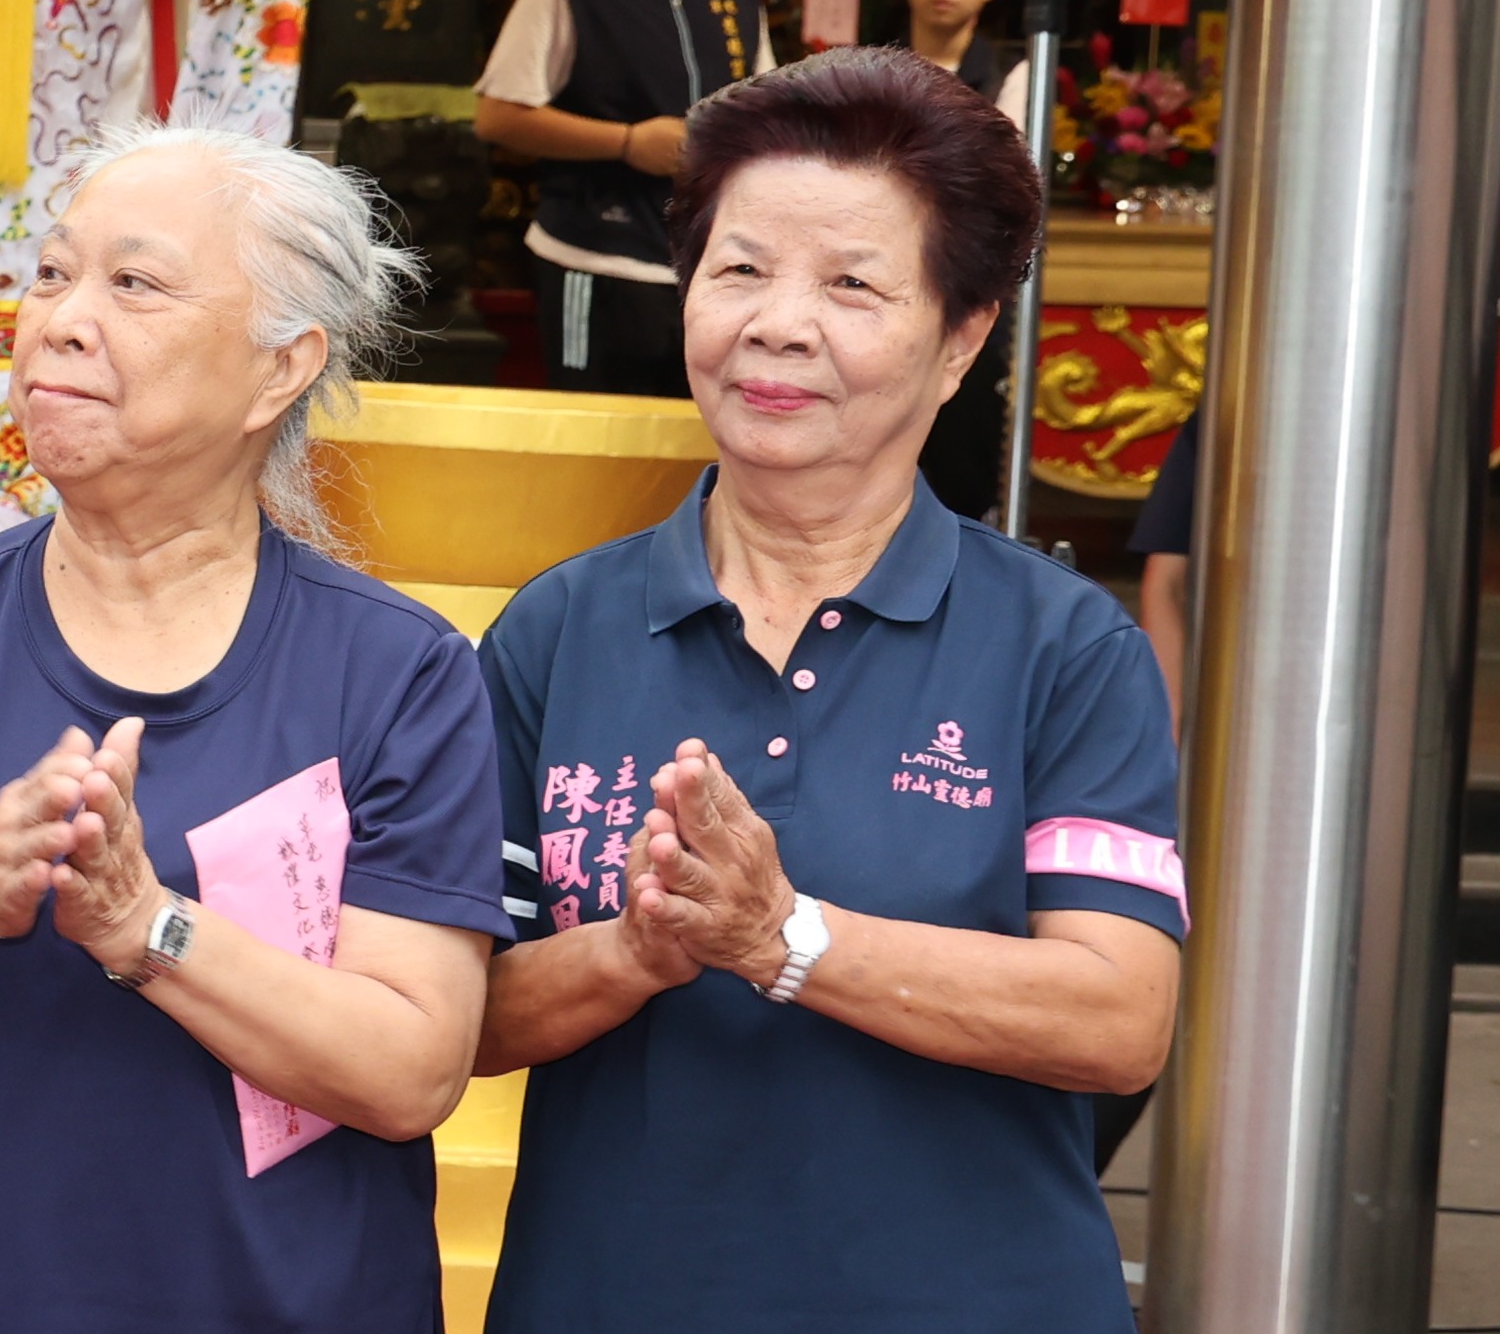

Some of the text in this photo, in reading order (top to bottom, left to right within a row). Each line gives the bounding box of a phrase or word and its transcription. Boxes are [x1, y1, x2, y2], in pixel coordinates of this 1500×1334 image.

[900, 752, 989, 780] LATITUDE
[593, 755, 639, 912] 主任委員
